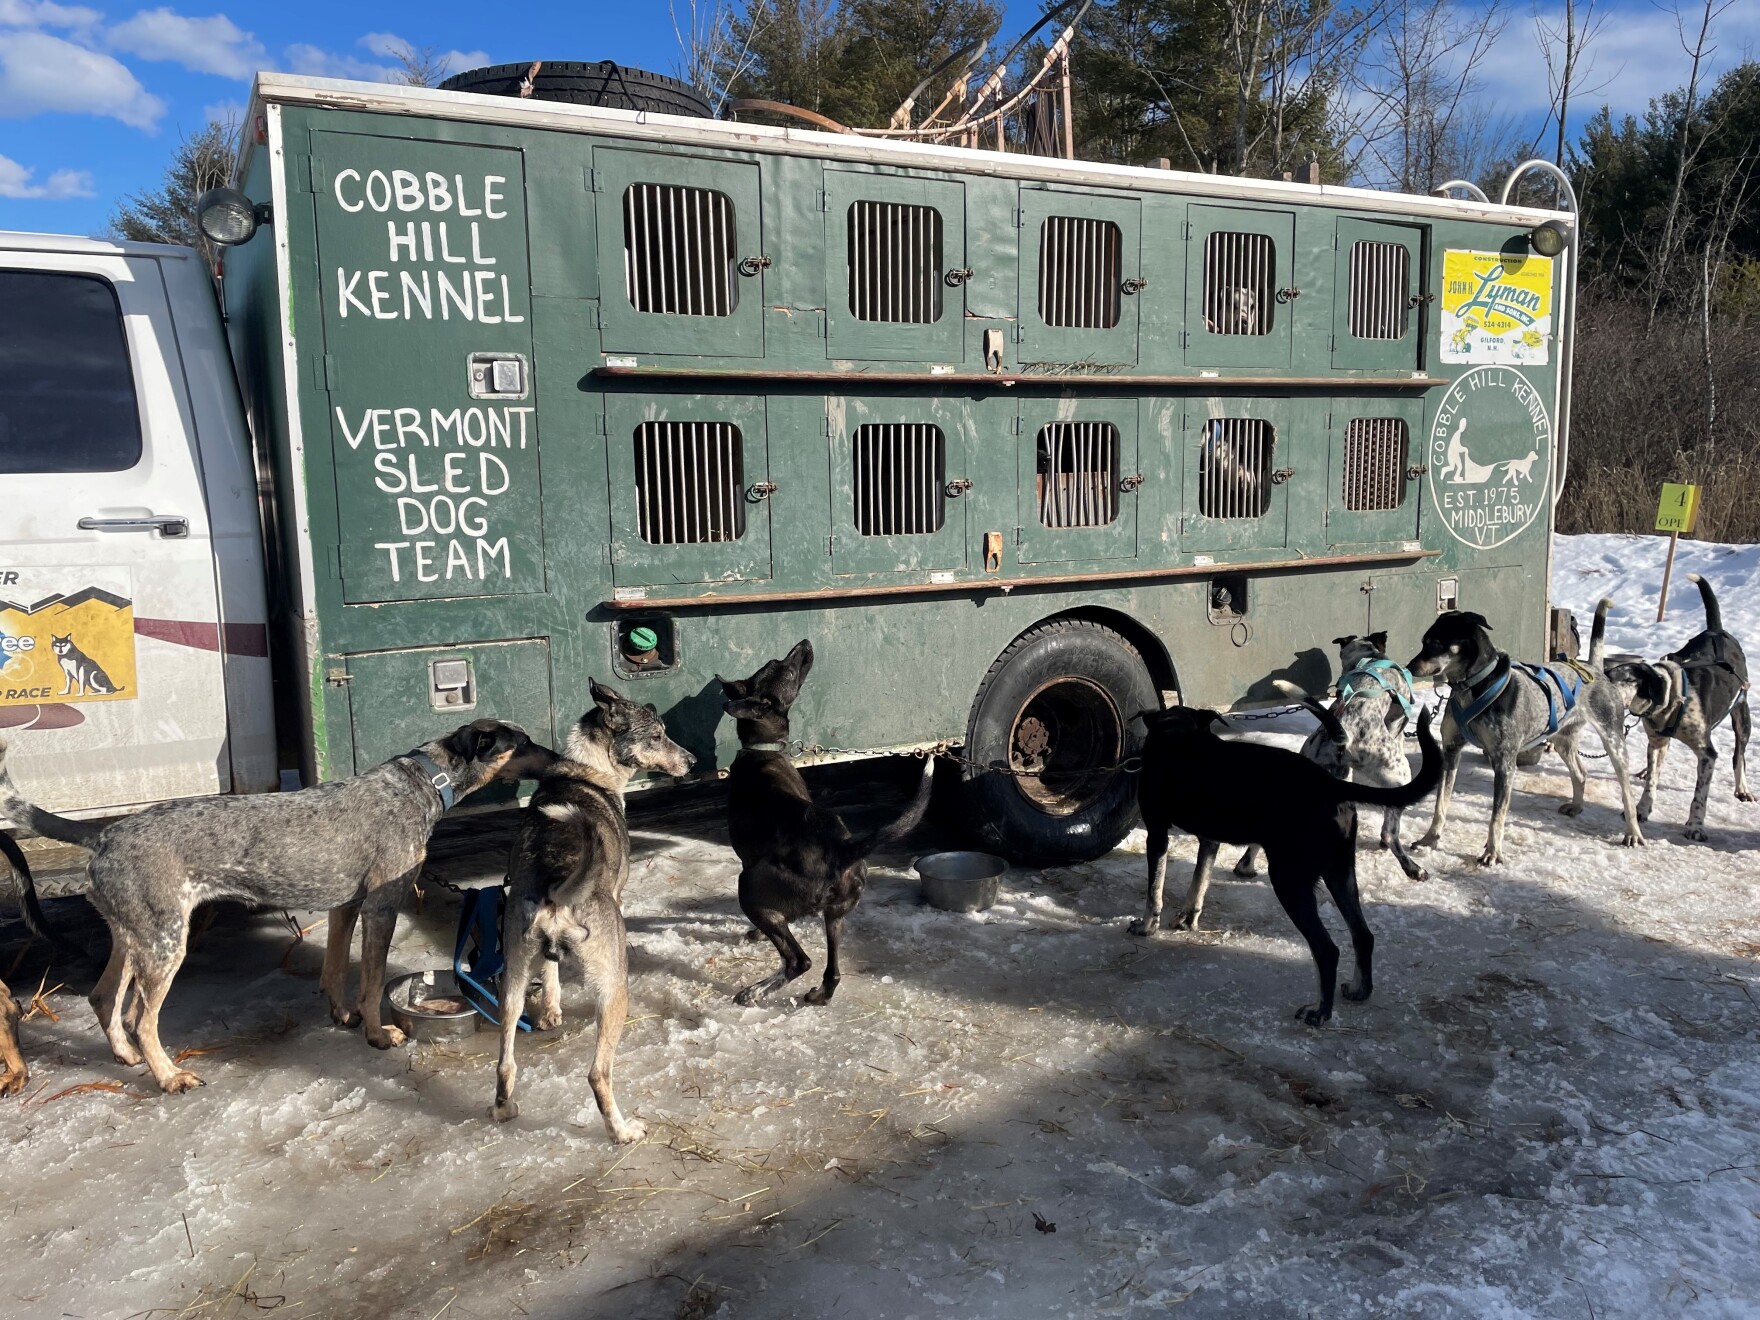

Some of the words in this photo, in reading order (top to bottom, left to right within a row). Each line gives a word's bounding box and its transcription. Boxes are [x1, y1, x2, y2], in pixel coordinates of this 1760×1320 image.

[334, 168, 508, 219] COBBLE
[387, 221, 497, 264] HILL
[1474, 256, 1522, 264] CONSTRUCTION
[337, 267, 524, 324] KENNEL
[1448, 280, 1467, 295] JOHN
[1455, 264, 1541, 319] Lyman
[1494, 304, 1506, 312] AND
[335, 406, 535, 450] VERMONT
[1433, 386, 1466, 466] COBBLE
[1469, 370, 1506, 391] HILL
[1511, 377, 1548, 450] KENNEL
[374, 452, 509, 495] SLED
[1444, 490, 1479, 508] EST.
[1484, 488, 1520, 505] 1975
[1674, 490, 1686, 507] 4
[396, 495, 488, 537] DOG
[1451, 503, 1533, 529] MIDDLEBURY
[1474, 525, 1501, 545] VT
[374, 537, 511, 582] TEAM
[0, 636, 35, 652] ee
[5, 687, 52, 700] RACE
